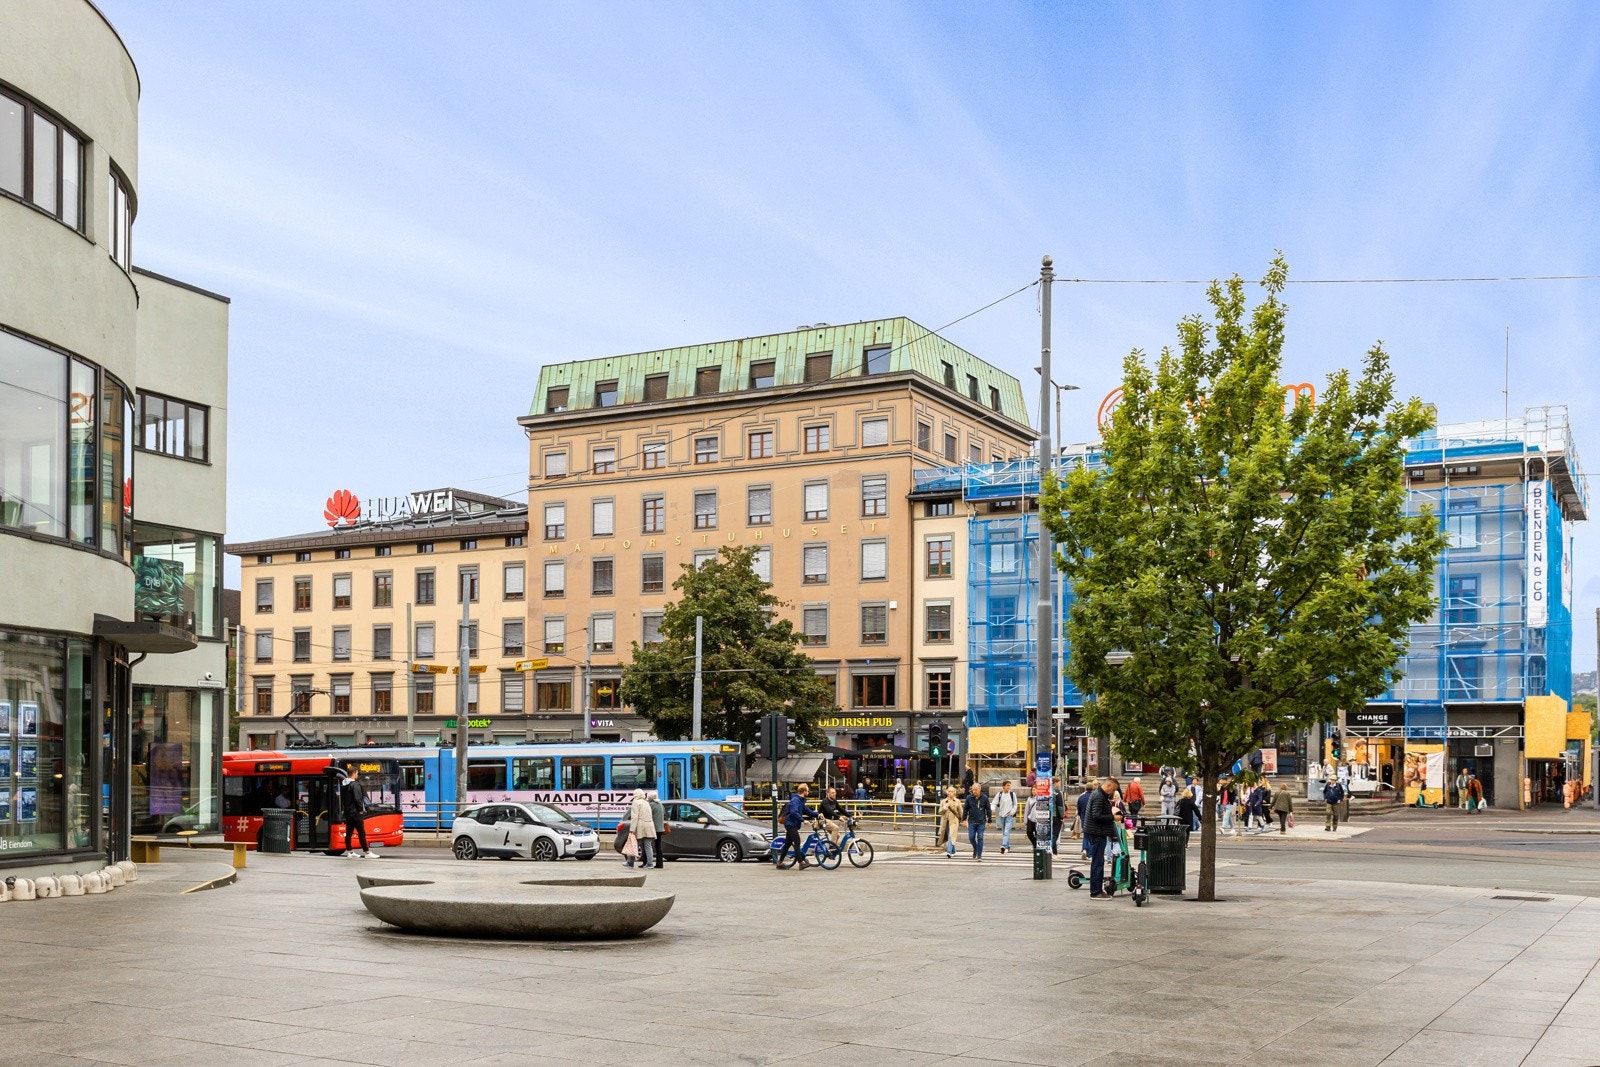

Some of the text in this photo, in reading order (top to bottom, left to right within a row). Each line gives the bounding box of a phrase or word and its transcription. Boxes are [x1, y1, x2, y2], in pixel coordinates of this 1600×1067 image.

[365, 490, 453, 519] HUAWEI
[549, 522, 877, 554] MAJORSTUHUSET
[1533, 487, 1543, 601] BRENDEN & CO
[145, 577, 161, 589] DNB
[818, 717, 893, 727] OLD IRISH PUB
[534, 793, 648, 806] MANO PIZ
